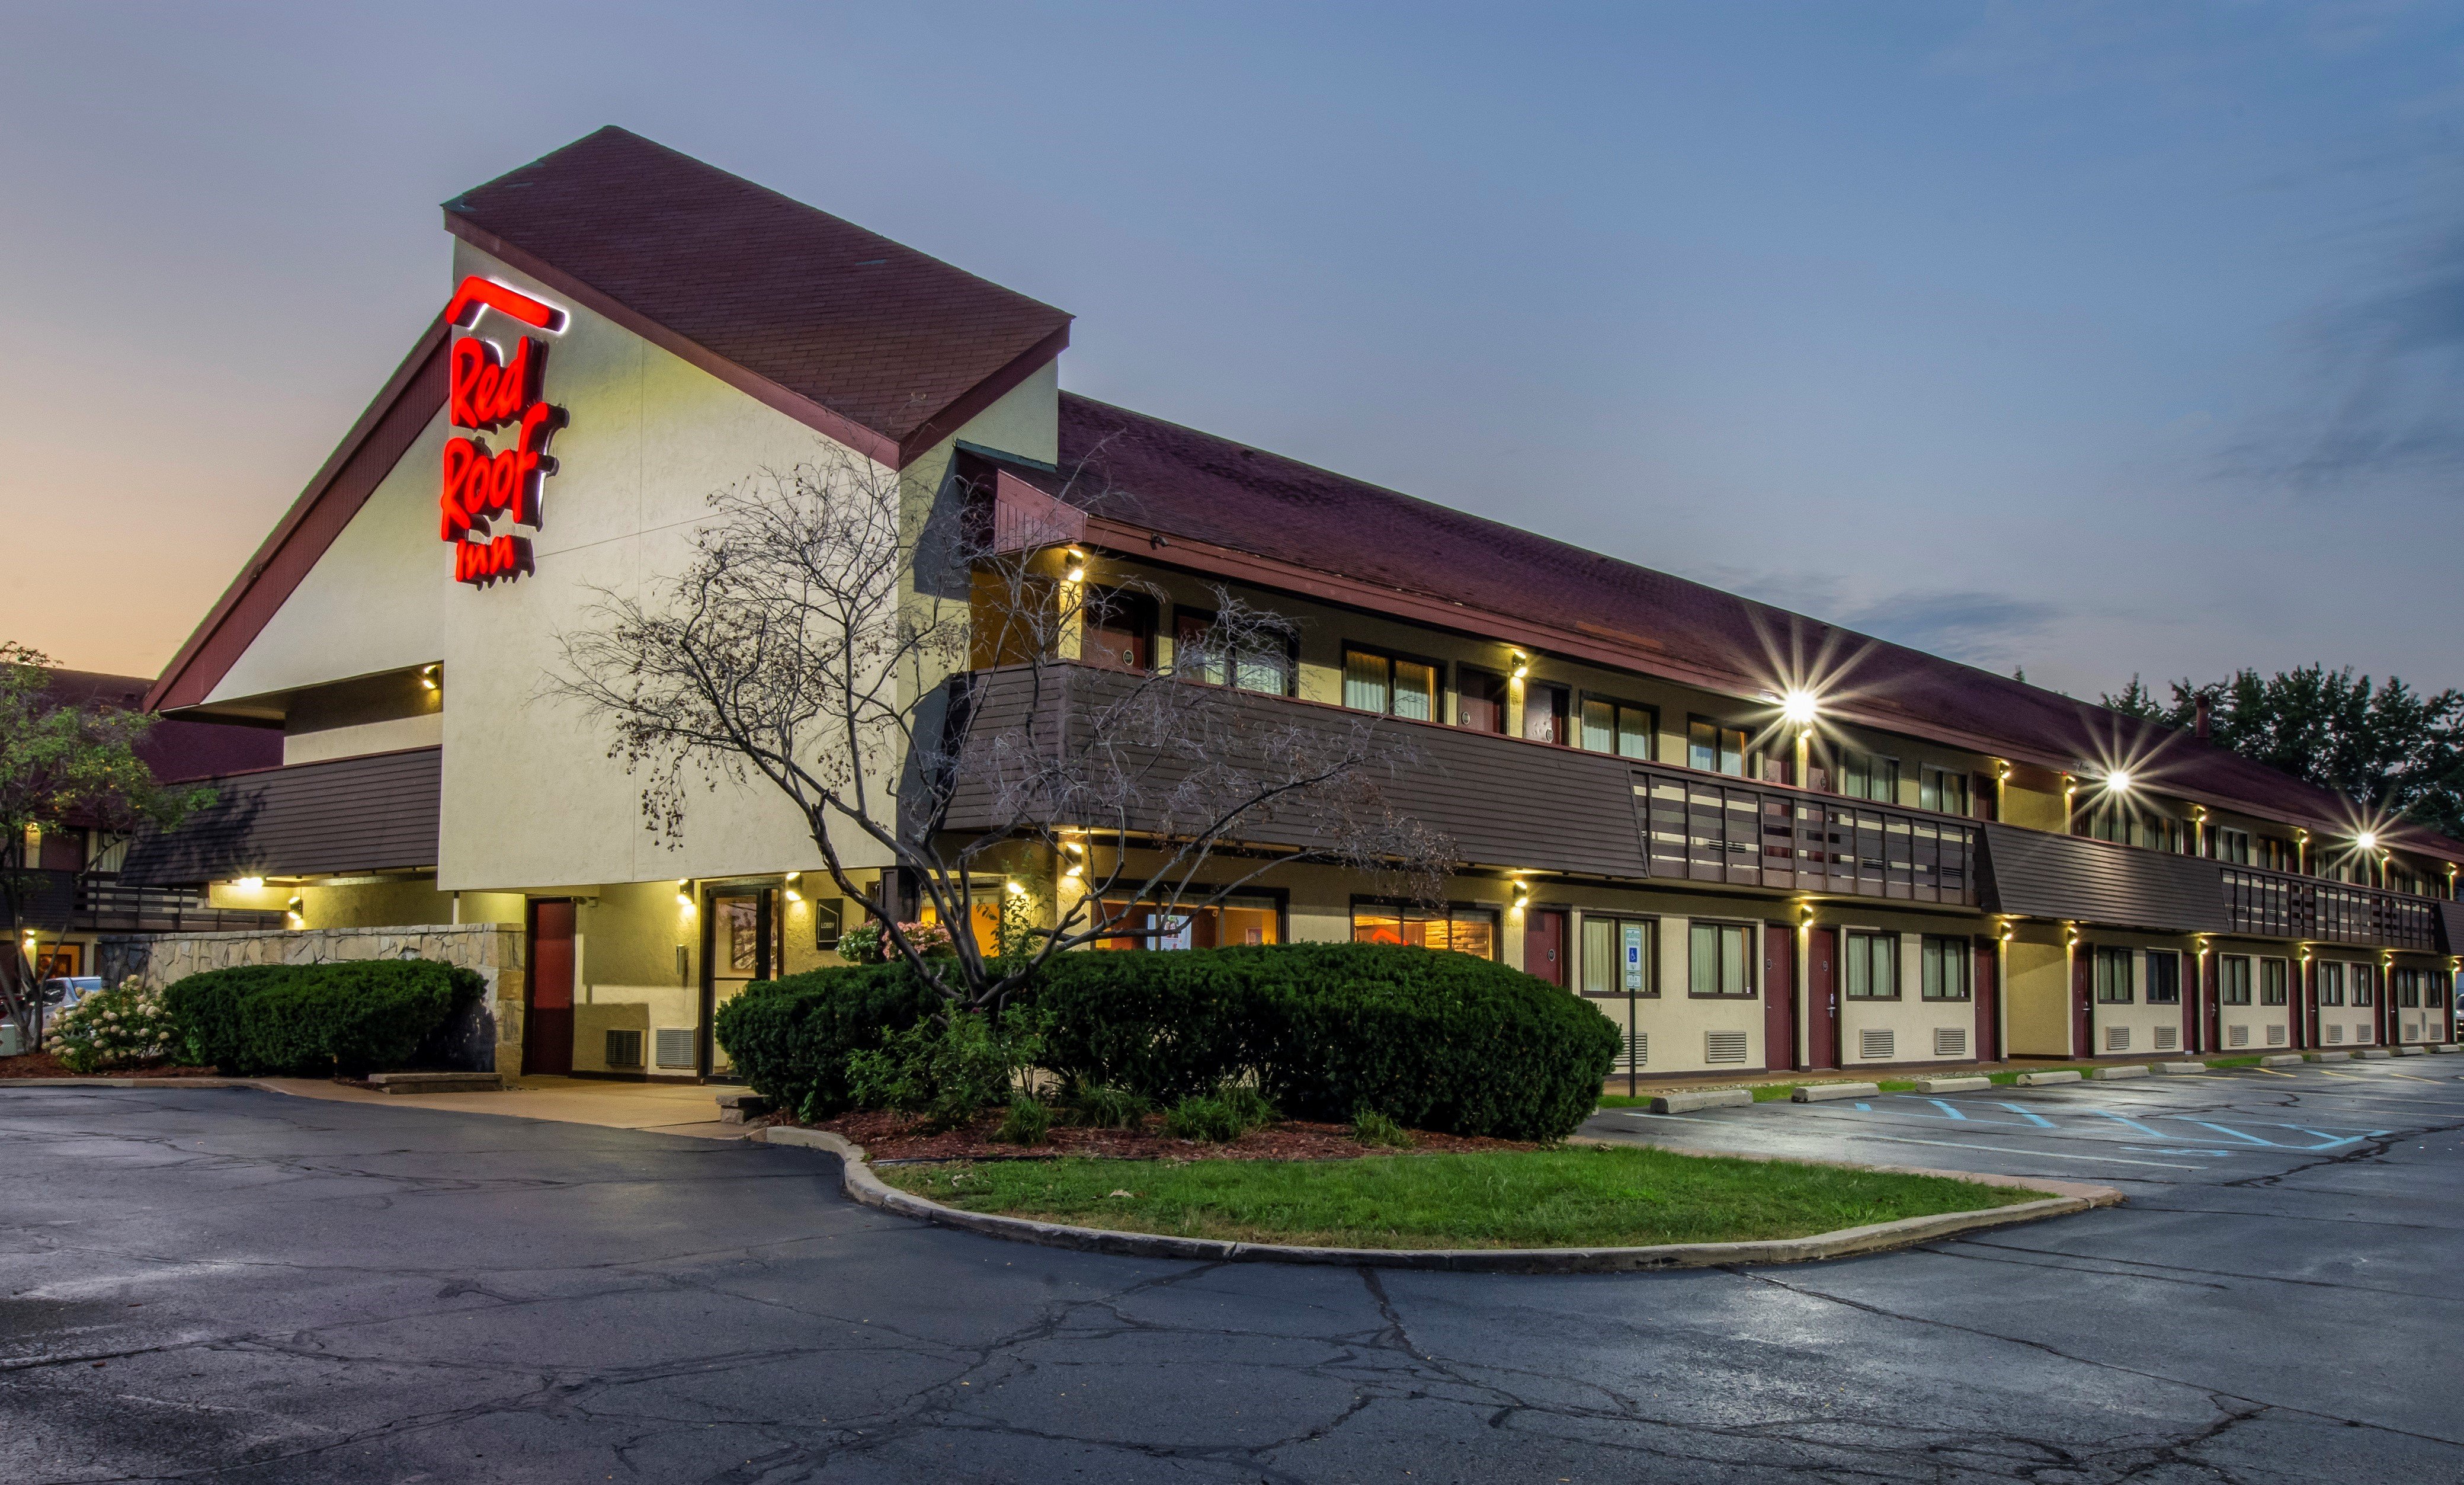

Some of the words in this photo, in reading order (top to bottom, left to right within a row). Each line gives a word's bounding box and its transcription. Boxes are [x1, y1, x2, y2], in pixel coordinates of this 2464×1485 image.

[451, 335, 528, 428] Red
[441, 402, 549, 541] Roof
[456, 535, 514, 582] Inn
